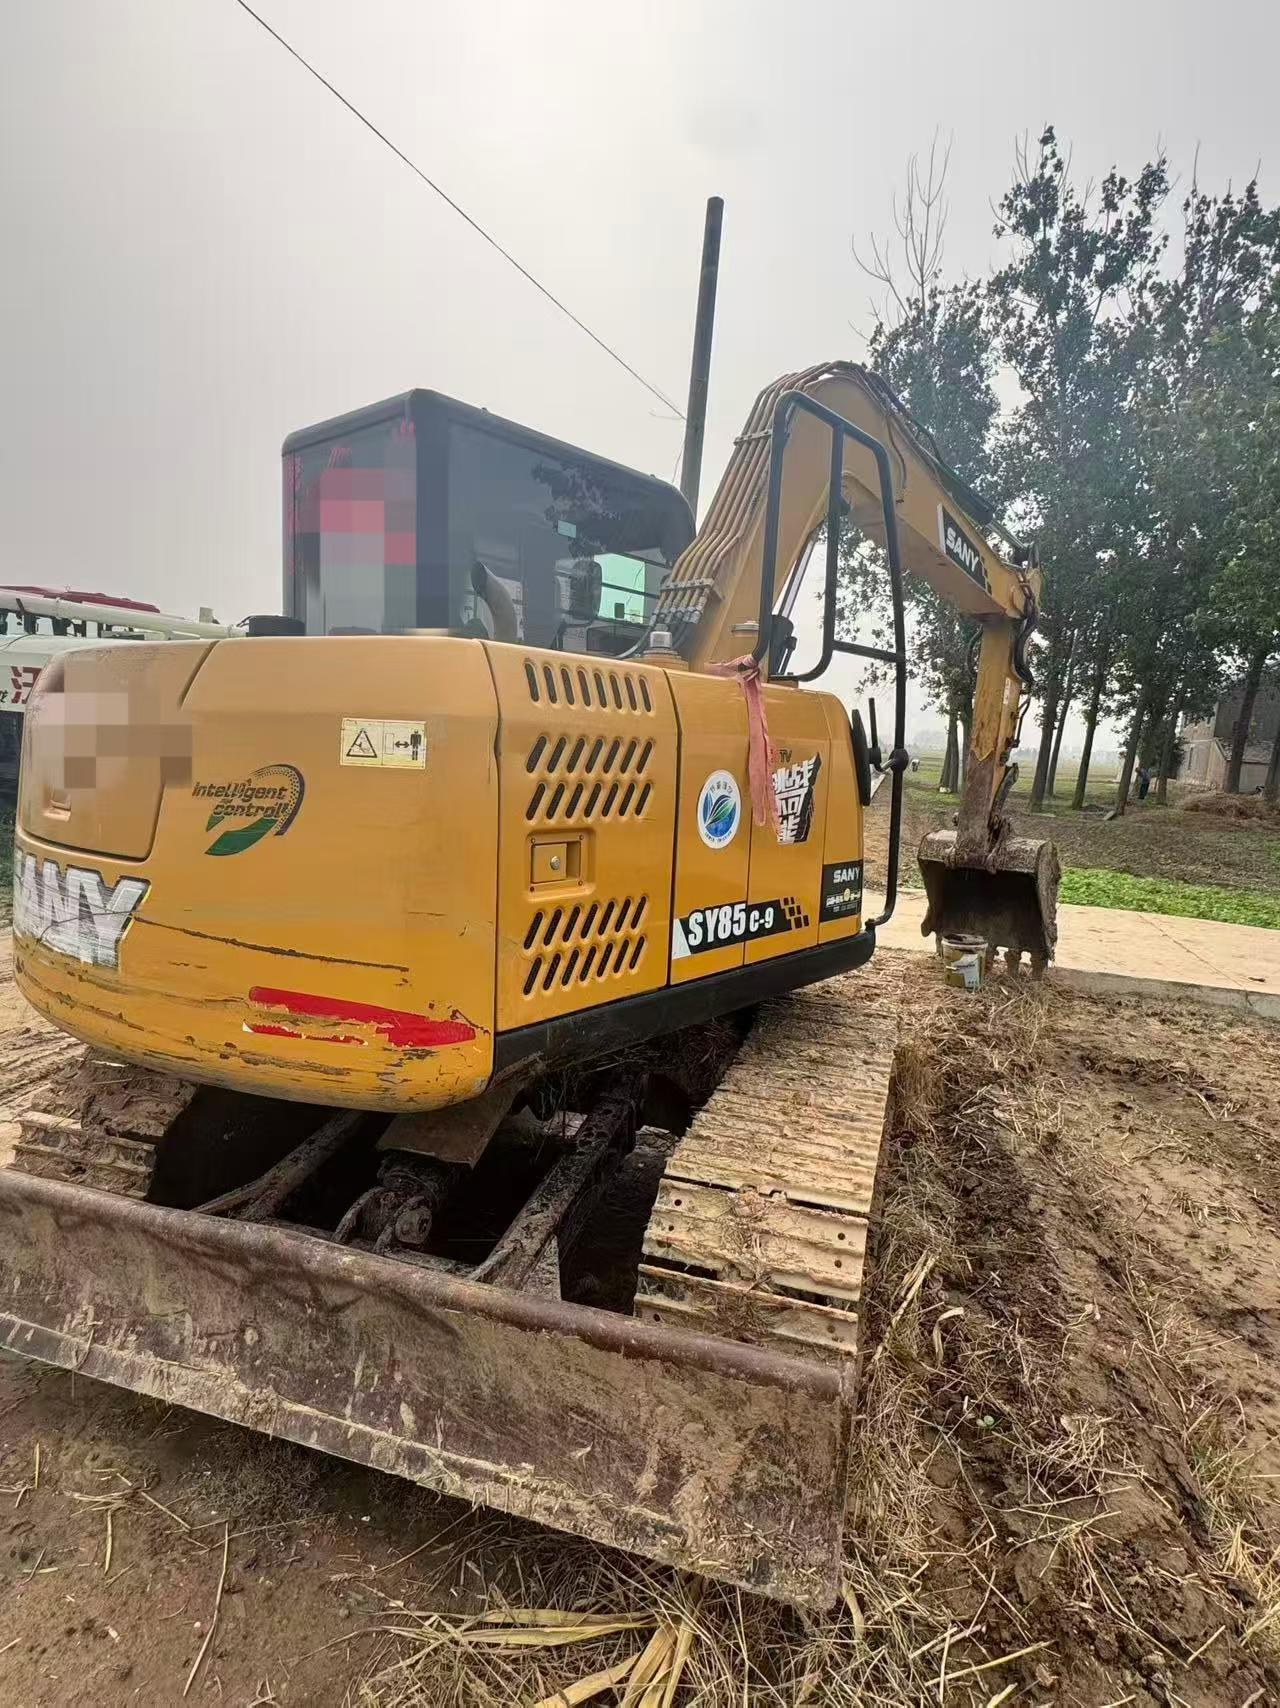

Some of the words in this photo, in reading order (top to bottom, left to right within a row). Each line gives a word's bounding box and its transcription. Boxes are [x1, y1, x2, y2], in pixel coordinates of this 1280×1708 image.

[945, 527, 980, 572] SANY
[192, 778, 288, 803] intelligent
[833, 867, 860, 884] SANY
[688, 903, 746, 946] SY85
